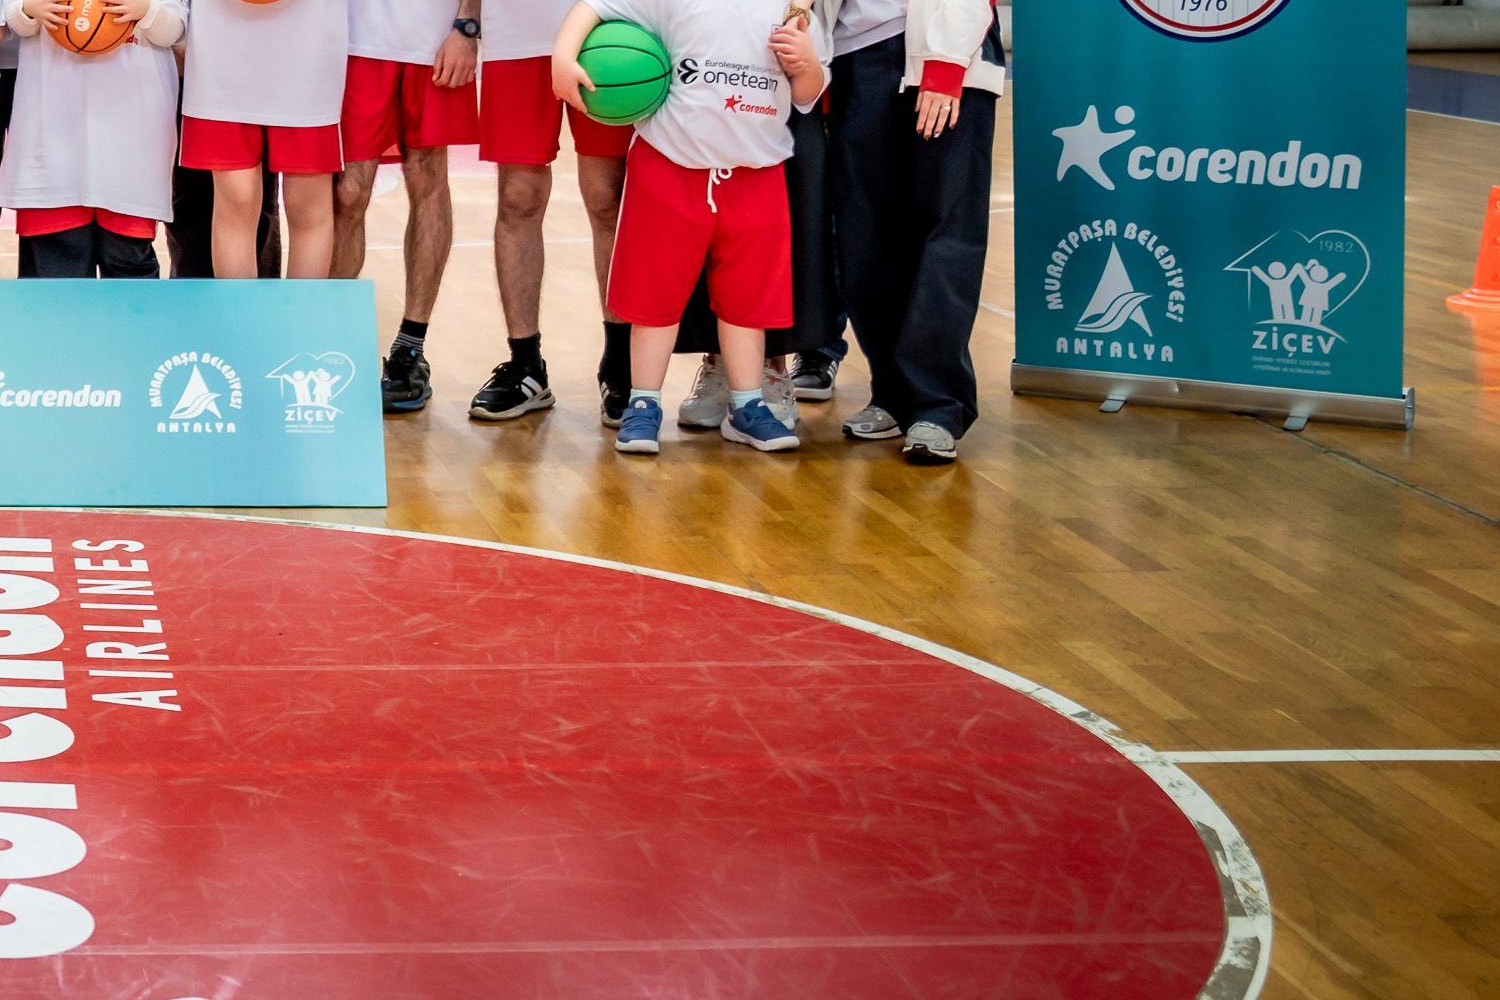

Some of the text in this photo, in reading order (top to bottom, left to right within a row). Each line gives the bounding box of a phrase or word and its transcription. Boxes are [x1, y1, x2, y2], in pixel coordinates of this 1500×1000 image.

[704, 59, 750, 72] Euroleague
[739, 103, 778, 117] corendon
[1126, 139, 1363, 190] corendon
[1319, 239, 1355, 254] 1982
[1043, 218, 1186, 323] MURATPAŞA BELEDİYESİ
[1055, 336, 1175, 363] ANTALYA
[1251, 326, 1337, 358] ZİÇEV
[148, 351, 243, 410] MURATPAŞA BELEDİYESİ
[0, 383, 122, 408] corendon
[156, 421, 237, 433] ANTALYA
[284, 406, 338, 425] ZİÇEV
[71, 536, 182, 712] AIRLINES
